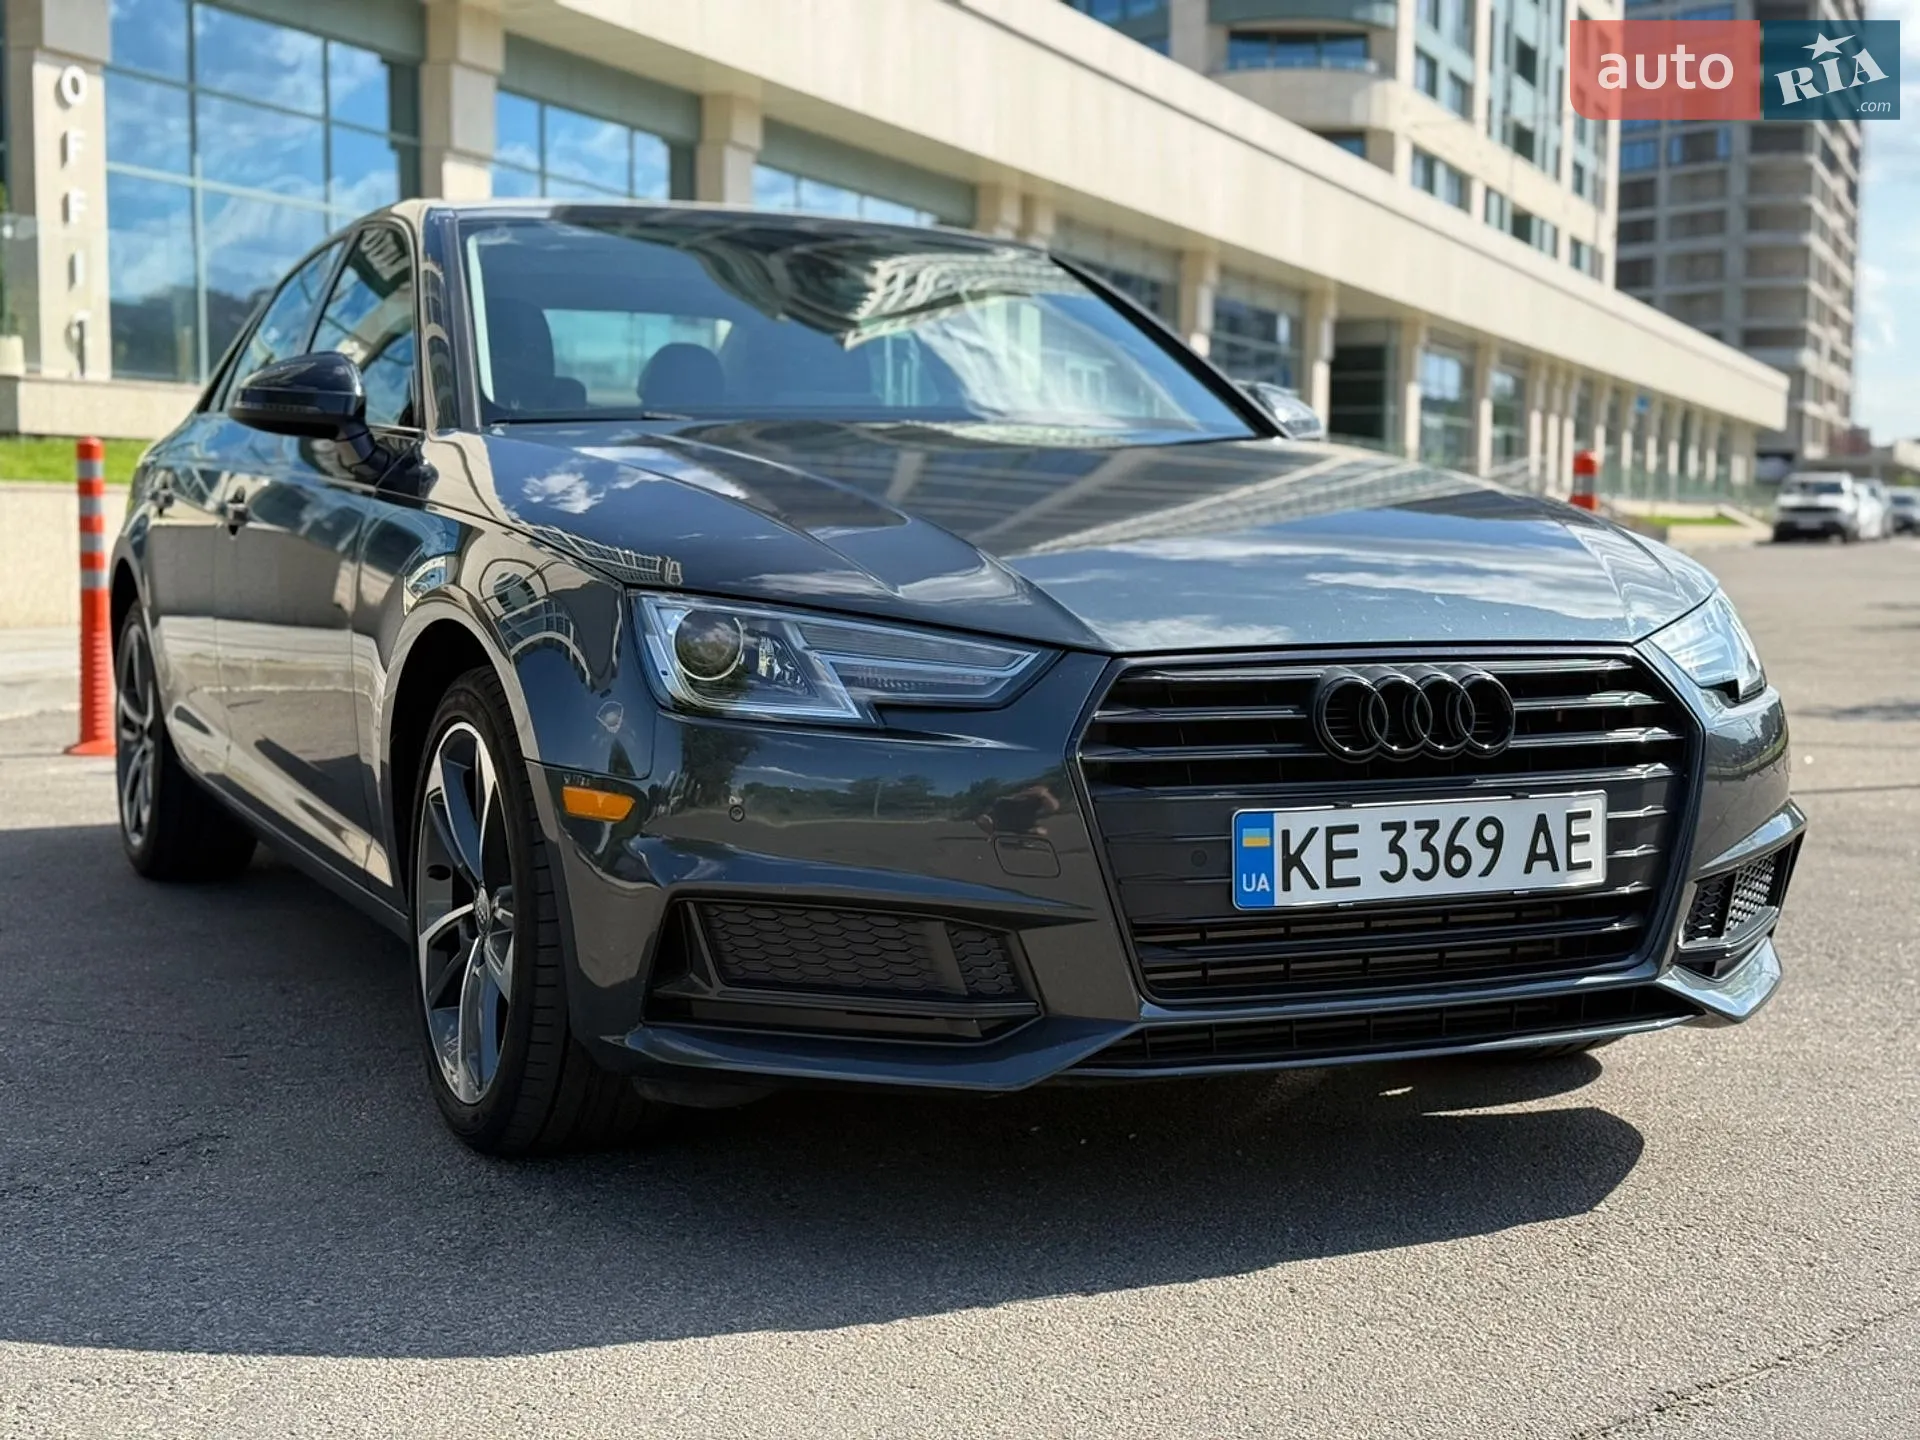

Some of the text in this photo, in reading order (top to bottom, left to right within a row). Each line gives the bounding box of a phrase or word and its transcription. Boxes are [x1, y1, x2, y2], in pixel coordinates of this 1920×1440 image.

[1281, 809, 1593, 892] KE 3369 AE
[1242, 873, 1270, 892] UA
